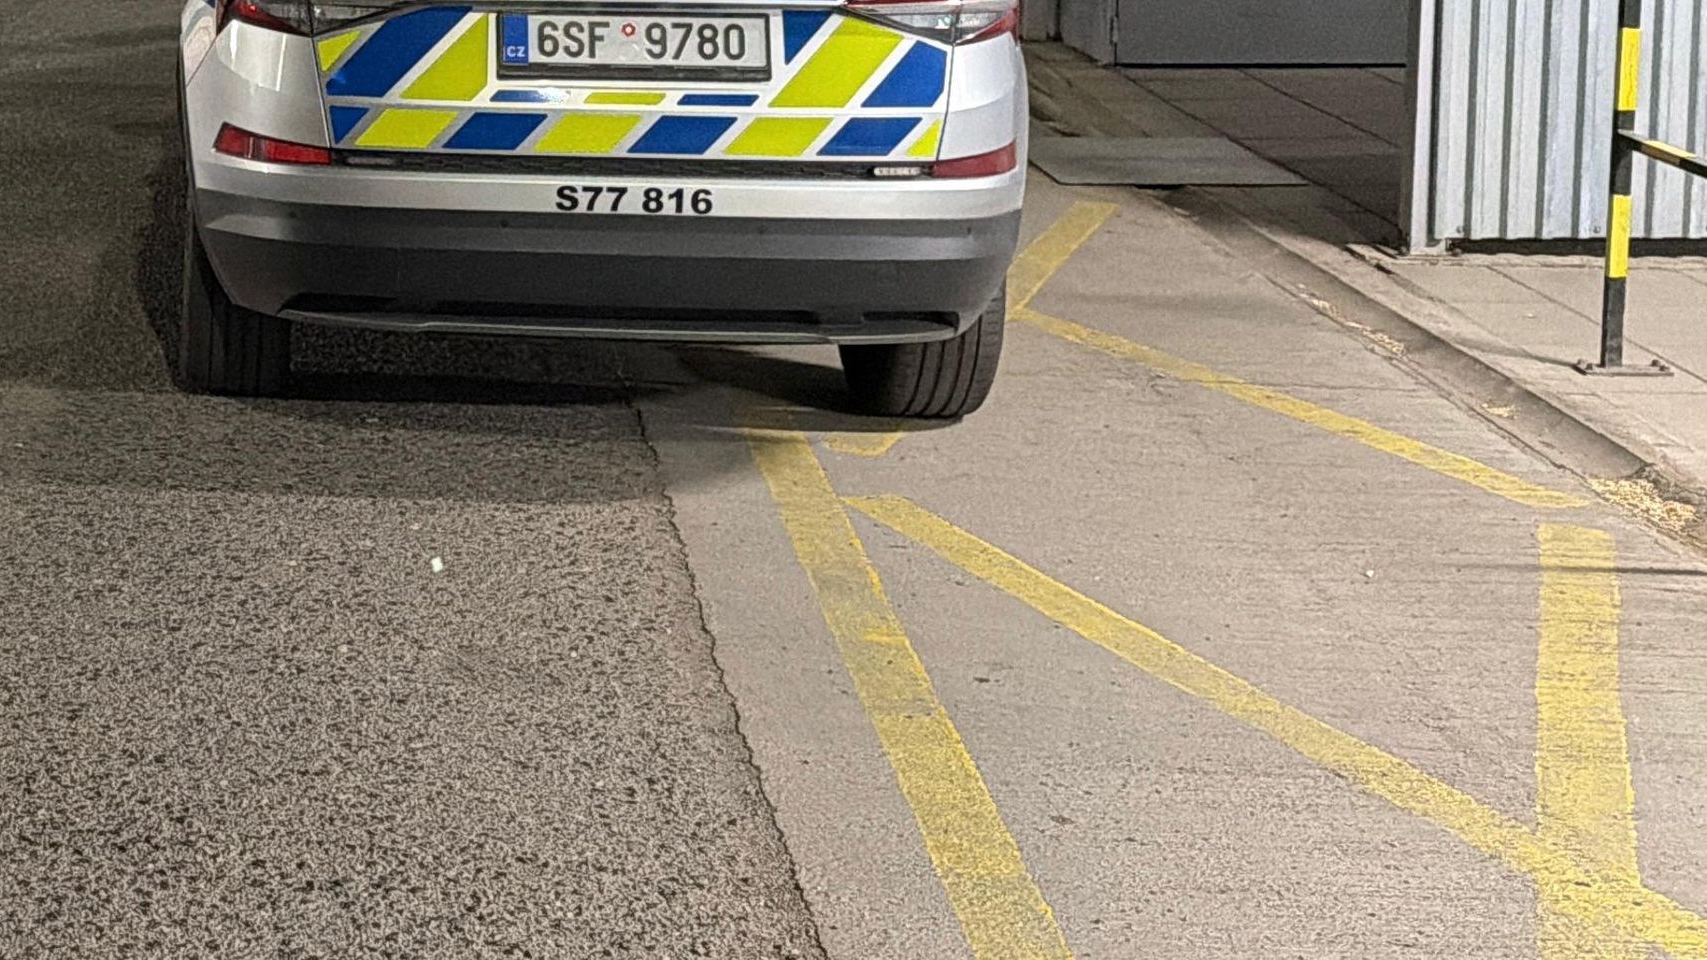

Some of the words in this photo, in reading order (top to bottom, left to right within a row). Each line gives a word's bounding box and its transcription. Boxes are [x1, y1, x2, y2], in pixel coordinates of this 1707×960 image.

[506, 46, 526, 58] CZ
[537, 20, 611, 59] 6SF
[644, 22, 746, 61] 9780
[555, 185, 628, 212] S77
[641, 187, 713, 215] 816
